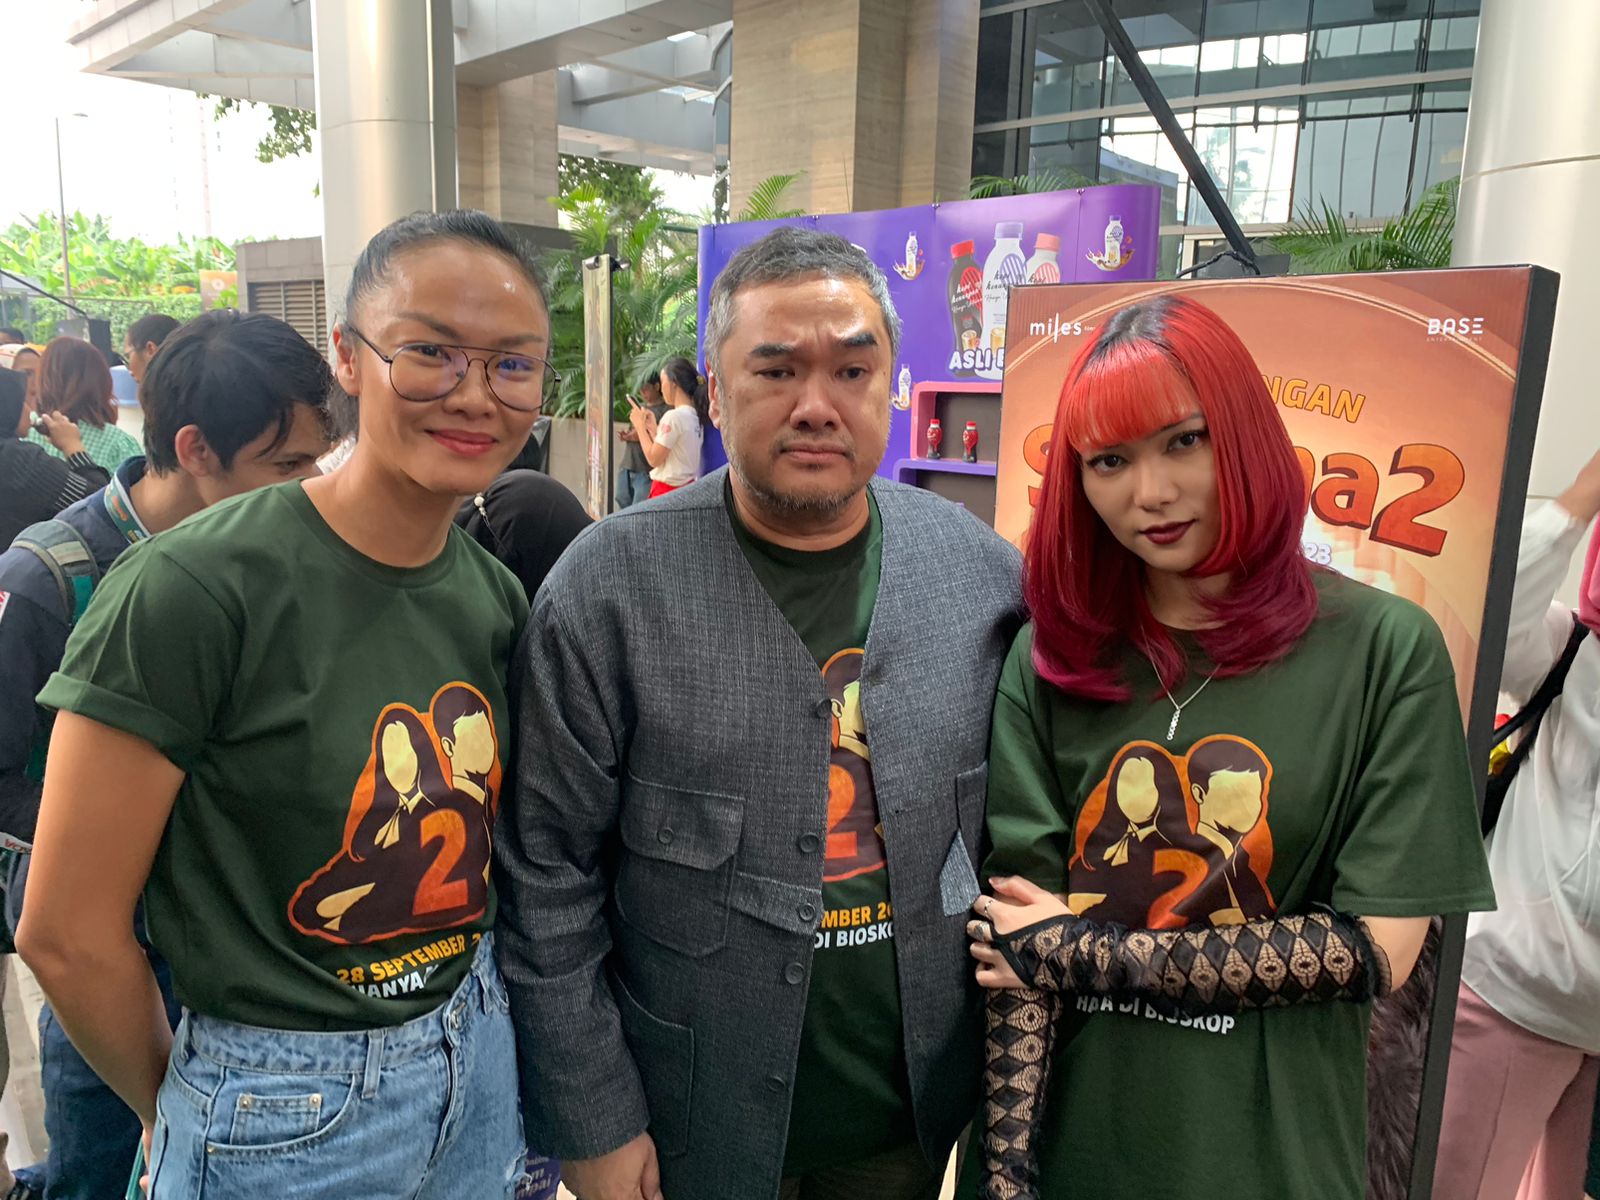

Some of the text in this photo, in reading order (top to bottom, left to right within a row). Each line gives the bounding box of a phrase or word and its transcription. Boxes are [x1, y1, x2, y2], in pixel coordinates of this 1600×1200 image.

[1029, 312, 1083, 344] miles
[1427, 317, 1485, 336] BASE
[949, 350, 991, 371] ASLI
[412, 809, 468, 915] 2
[821, 906, 872, 929] MBER
[336, 966, 365, 984] 28
[369, 934, 466, 982] SEPTEMBER
